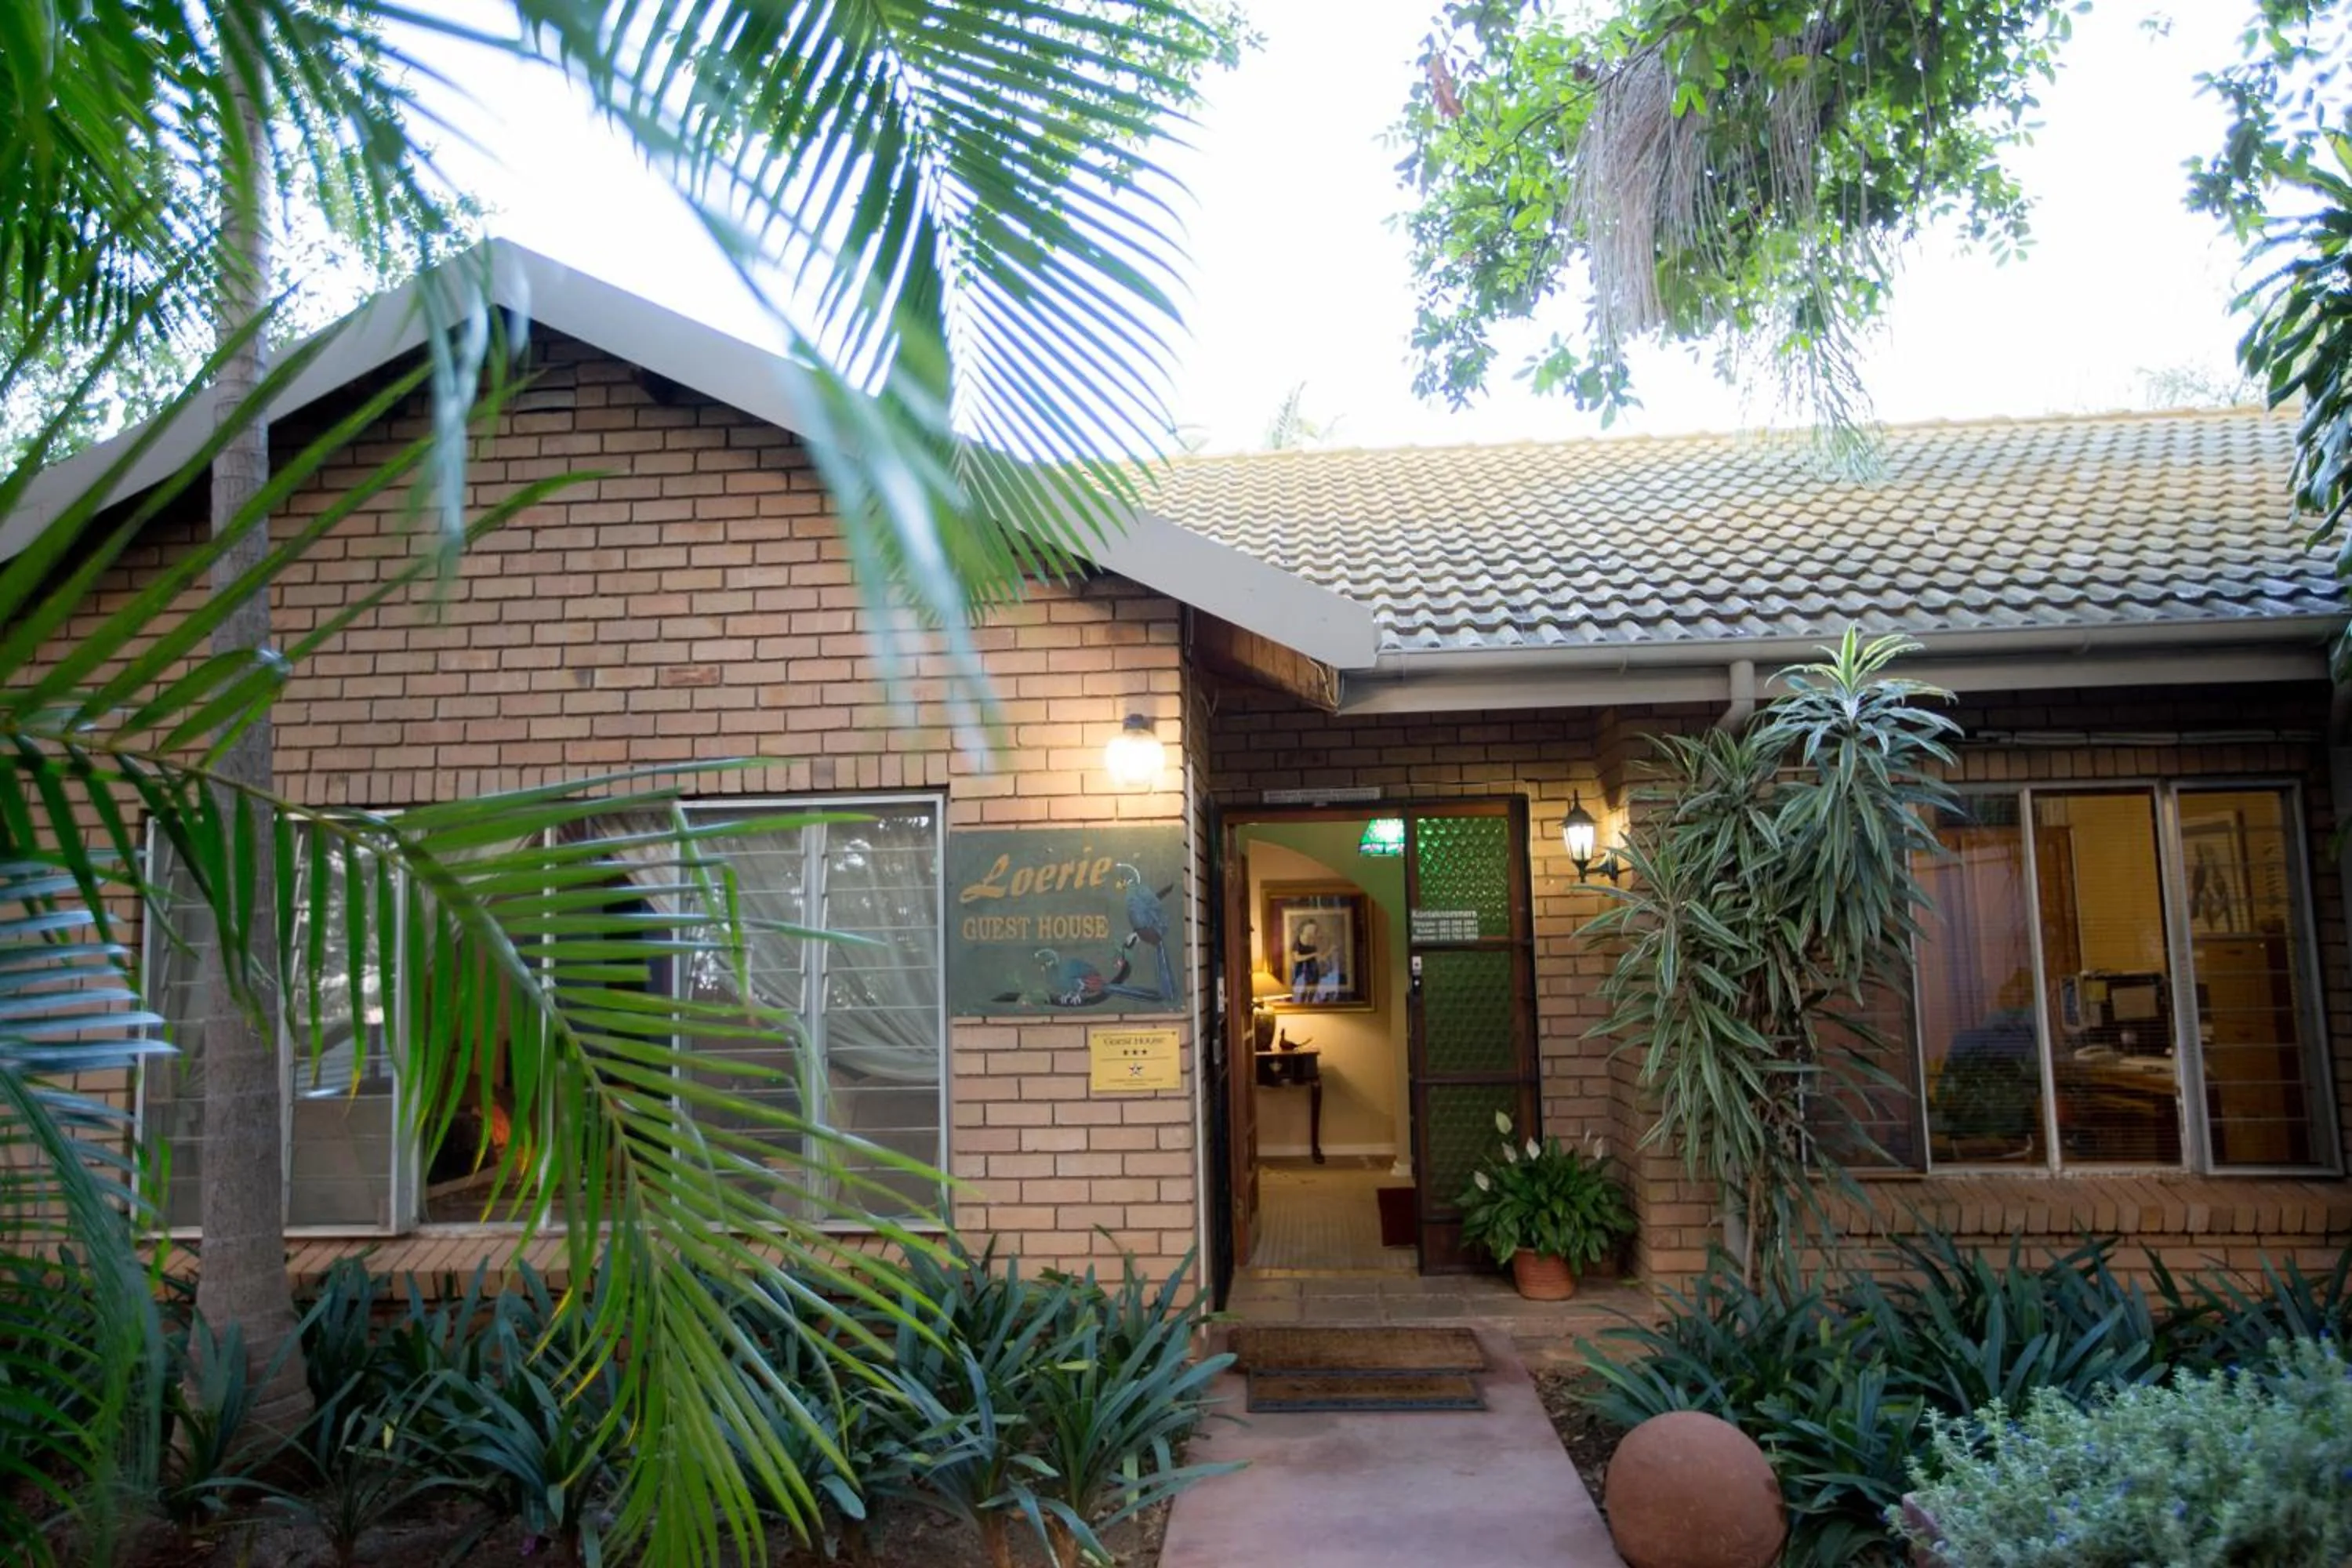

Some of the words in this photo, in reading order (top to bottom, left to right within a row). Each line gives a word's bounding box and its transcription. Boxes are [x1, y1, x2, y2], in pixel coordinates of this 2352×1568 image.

[960, 847, 1112, 903] Loerie
[962, 916, 1031, 940] GUEST
[1037, 915, 1110, 939] HOUSE
